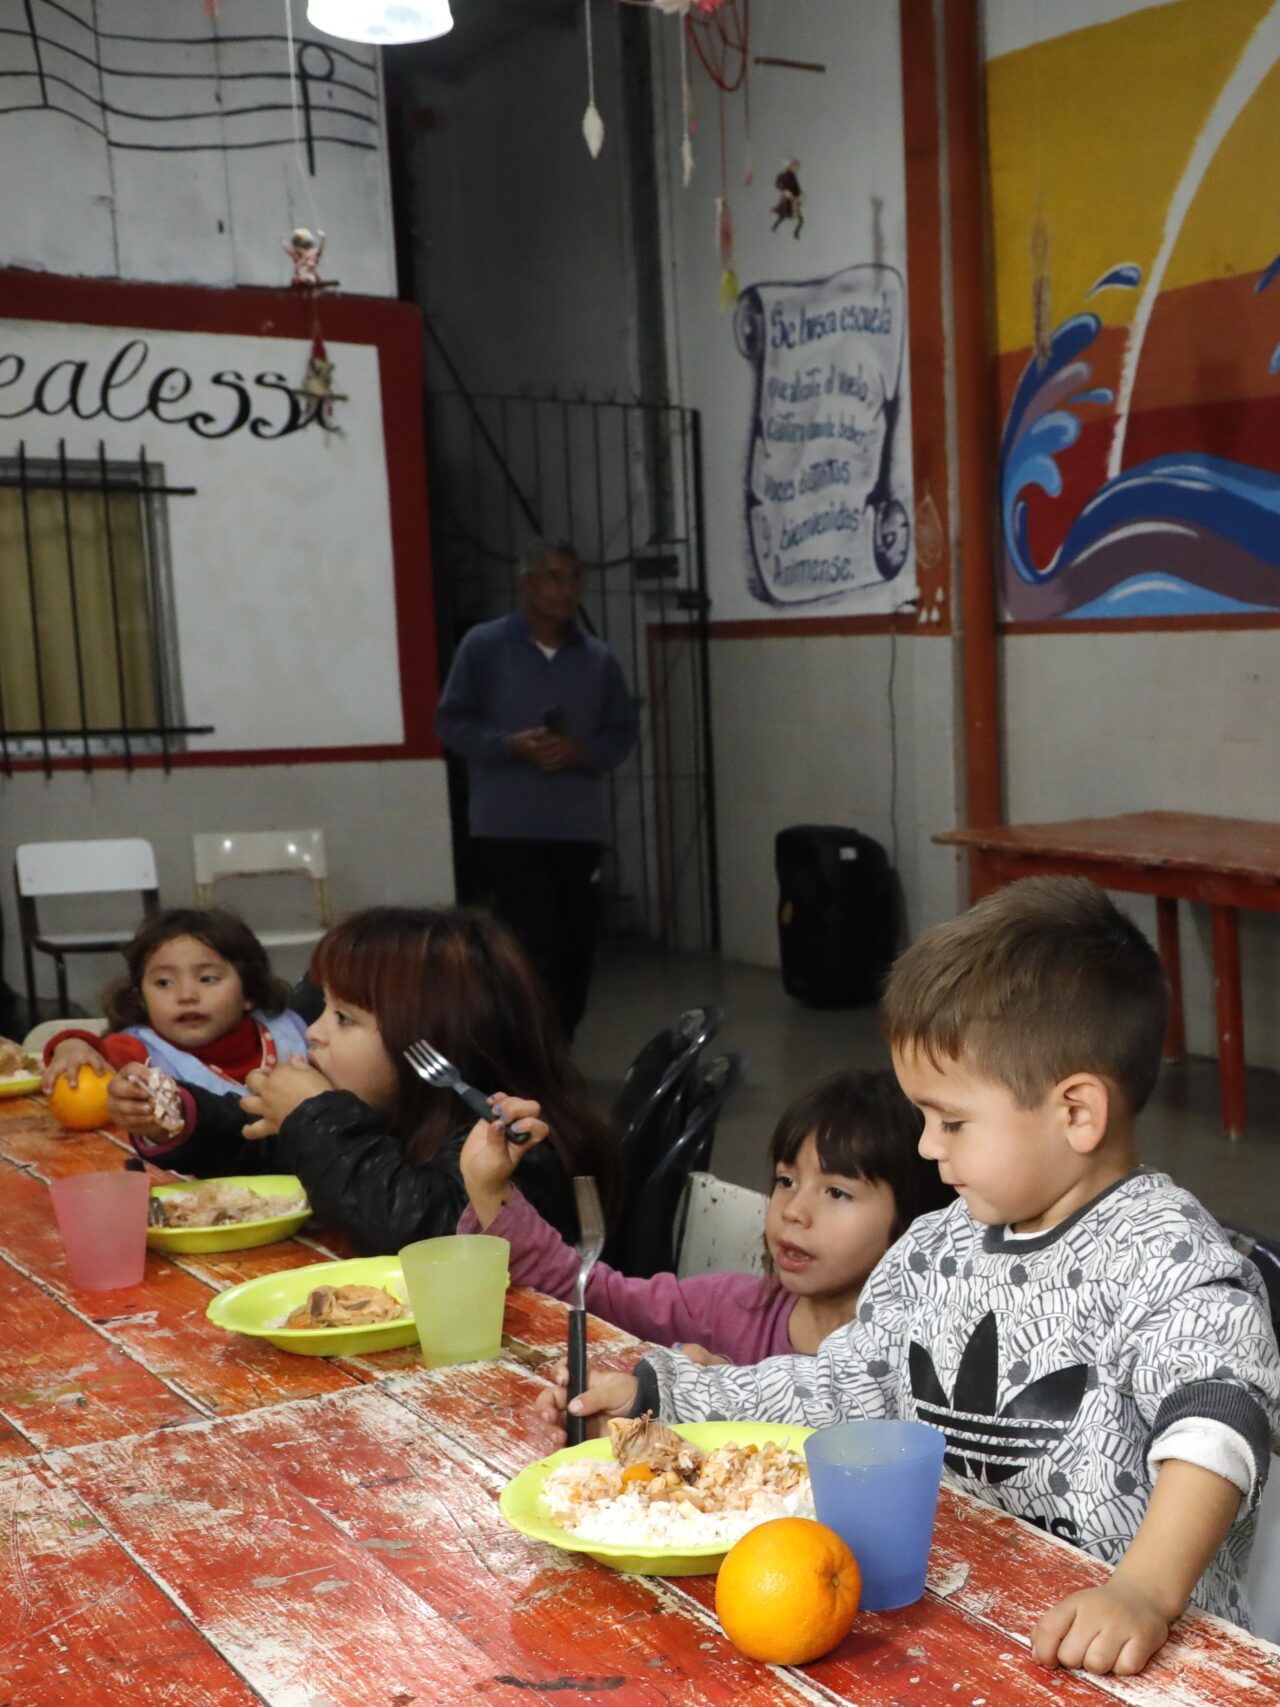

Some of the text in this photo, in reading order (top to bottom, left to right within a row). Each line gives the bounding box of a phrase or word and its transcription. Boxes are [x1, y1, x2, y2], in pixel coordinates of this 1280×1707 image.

[771, 291, 892, 350] Se busca escuela
